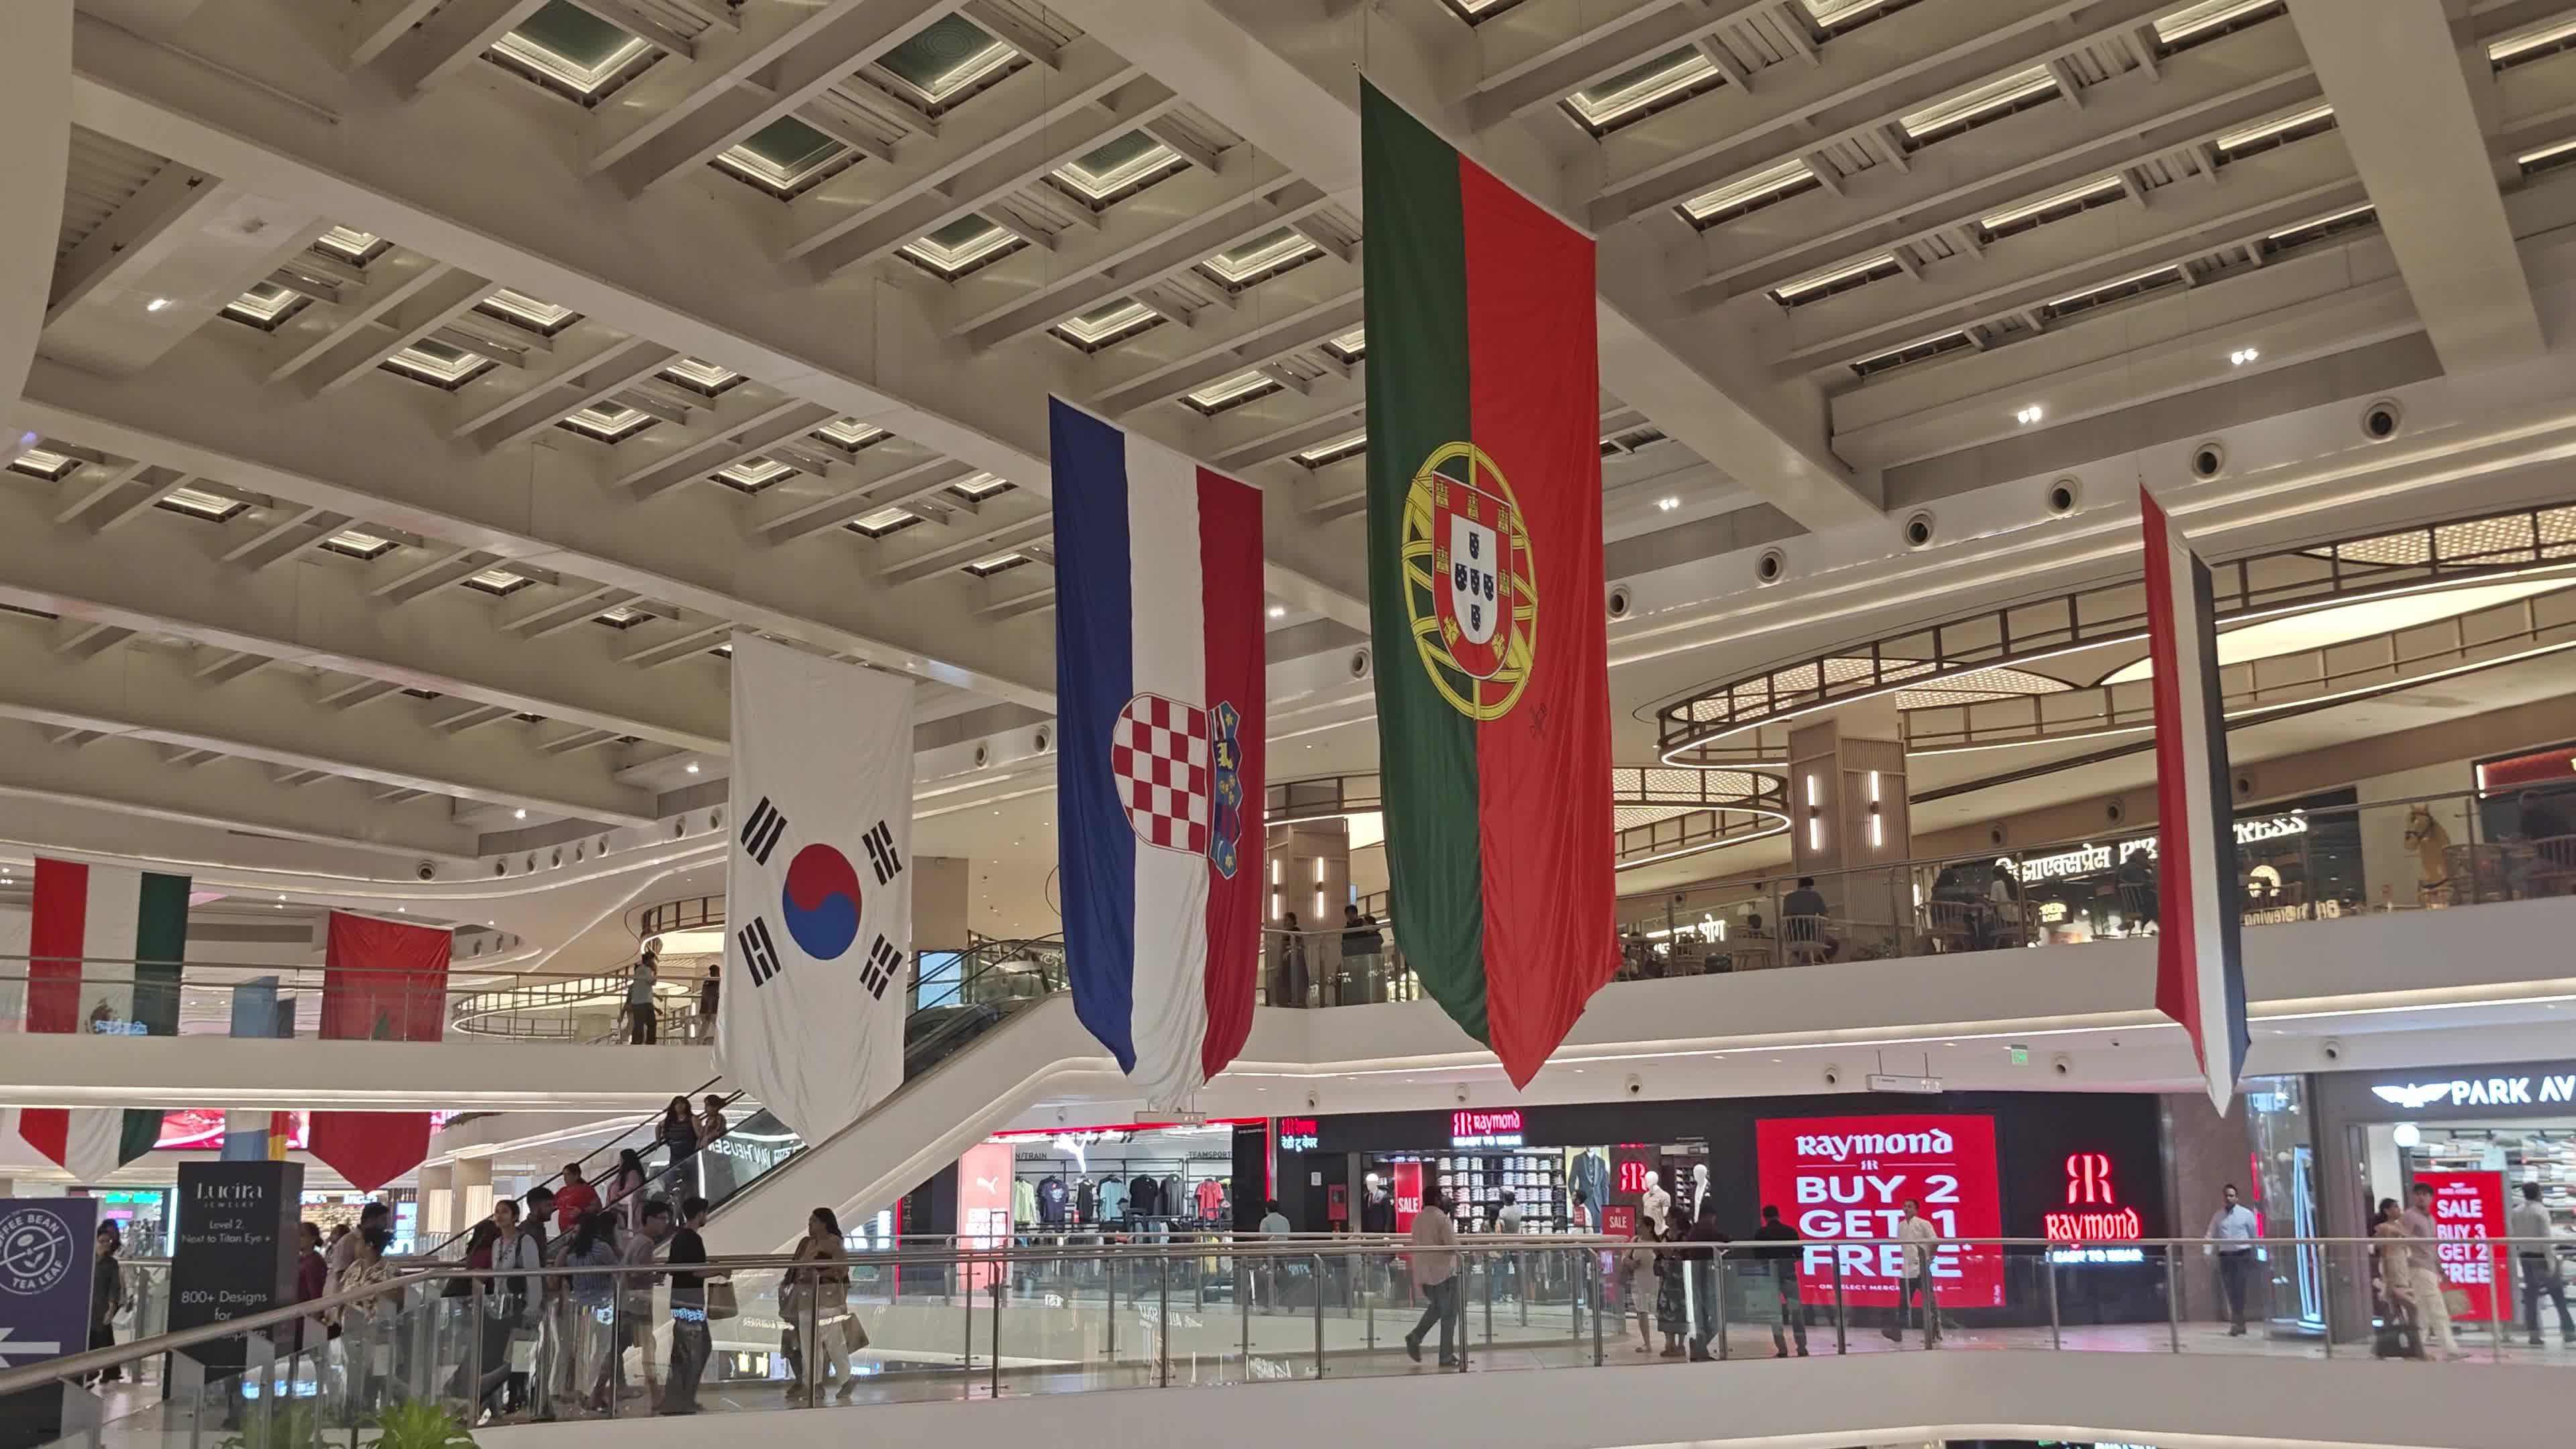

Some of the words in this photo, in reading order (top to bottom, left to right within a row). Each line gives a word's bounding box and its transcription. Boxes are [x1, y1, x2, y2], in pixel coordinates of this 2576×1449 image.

[2451, 1077, 2532, 1106] PARK
[1474, 1110, 1521, 1134] Raymond
[1795, 1128, 1953, 1161] Raymond
[197, 1183, 263, 1199] Lucira
[1796, 1175, 1907, 1203] BUY
[1925, 1175, 1960, 1203] 2
[1398, 1197, 1419, 1213] SALE
[2437, 1199, 2483, 1218] SALE
[0, 1216, 24, 1246] FFEE
[27, 1214, 60, 1233] BEAN
[209, 1219, 233, 1229] Level
[1609, 1216, 1627, 1229] SALE
[1799, 1210, 1905, 1238] GET
[1931, 1210, 1956, 1238] 1
[2045, 1207, 2139, 1249] Raymond
[2437, 1224, 2470, 1240] BUY
[2474, 1224, 2487, 1240] 3
[2438, 1243, 2472, 1261] GET
[2475, 1243, 2488, 1261] 2
[12, 1277, 36, 1289] TEA
[38, 1260, 64, 1285] LEAF
[2441, 1263, 2490, 1284] FREE
[181, 1291, 215, 1303] 800+
[219, 1290, 268, 1306] Designs
[214, 1307, 231, 1321] for
